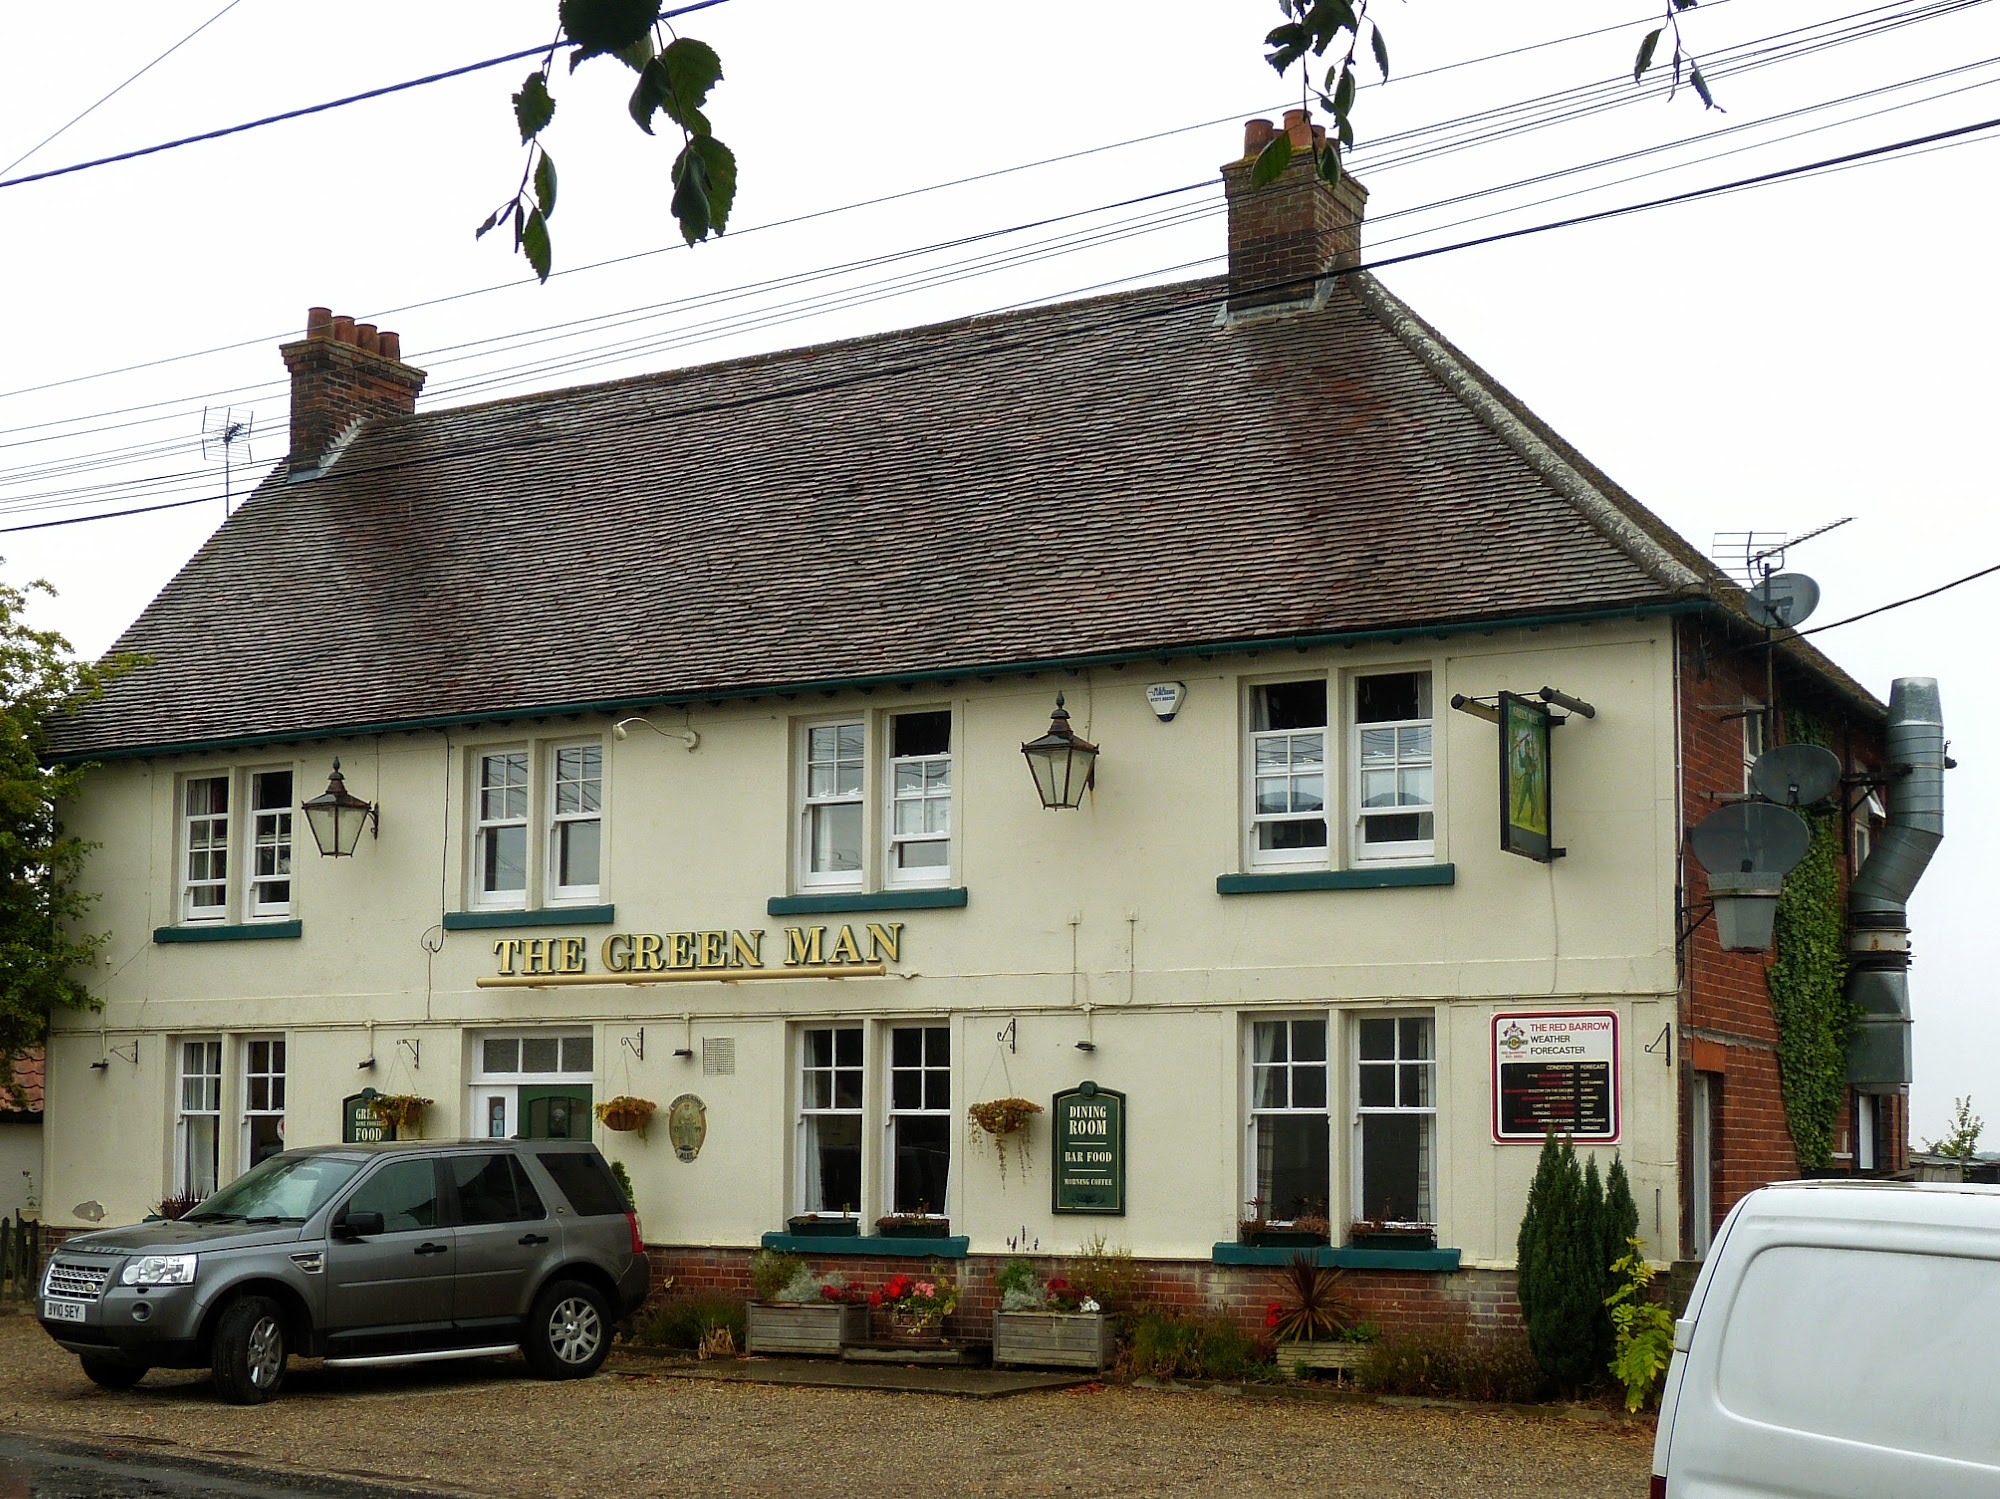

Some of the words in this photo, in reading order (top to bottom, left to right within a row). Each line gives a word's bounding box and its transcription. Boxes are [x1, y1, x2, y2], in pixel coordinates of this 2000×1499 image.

[494, 936, 585, 975] THE
[601, 929, 765, 972] GREEN
[784, 922, 904, 965] MAN
[1530, 1023, 1548, 1032] THE
[1549, 1023, 1567, 1031] RED
[1569, 1022, 1609, 1031] BARROW
[1530, 1035, 1570, 1043] WEATHER
[1530, 1046, 1585, 1055] FORECASTER
[355, 1108, 381, 1120] GREA
[1069, 1105, 1106, 1118] DINING
[1069, 1119, 1107, 1135] ROOM
[355, 1127, 382, 1141] FOOD
[1064, 1151, 1084, 1162] BAR
[1086, 1151, 1112, 1162] FOOD
[1091, 1178, 1112, 1186] COFFEE
[64, 1303, 80, 1319] SEY
